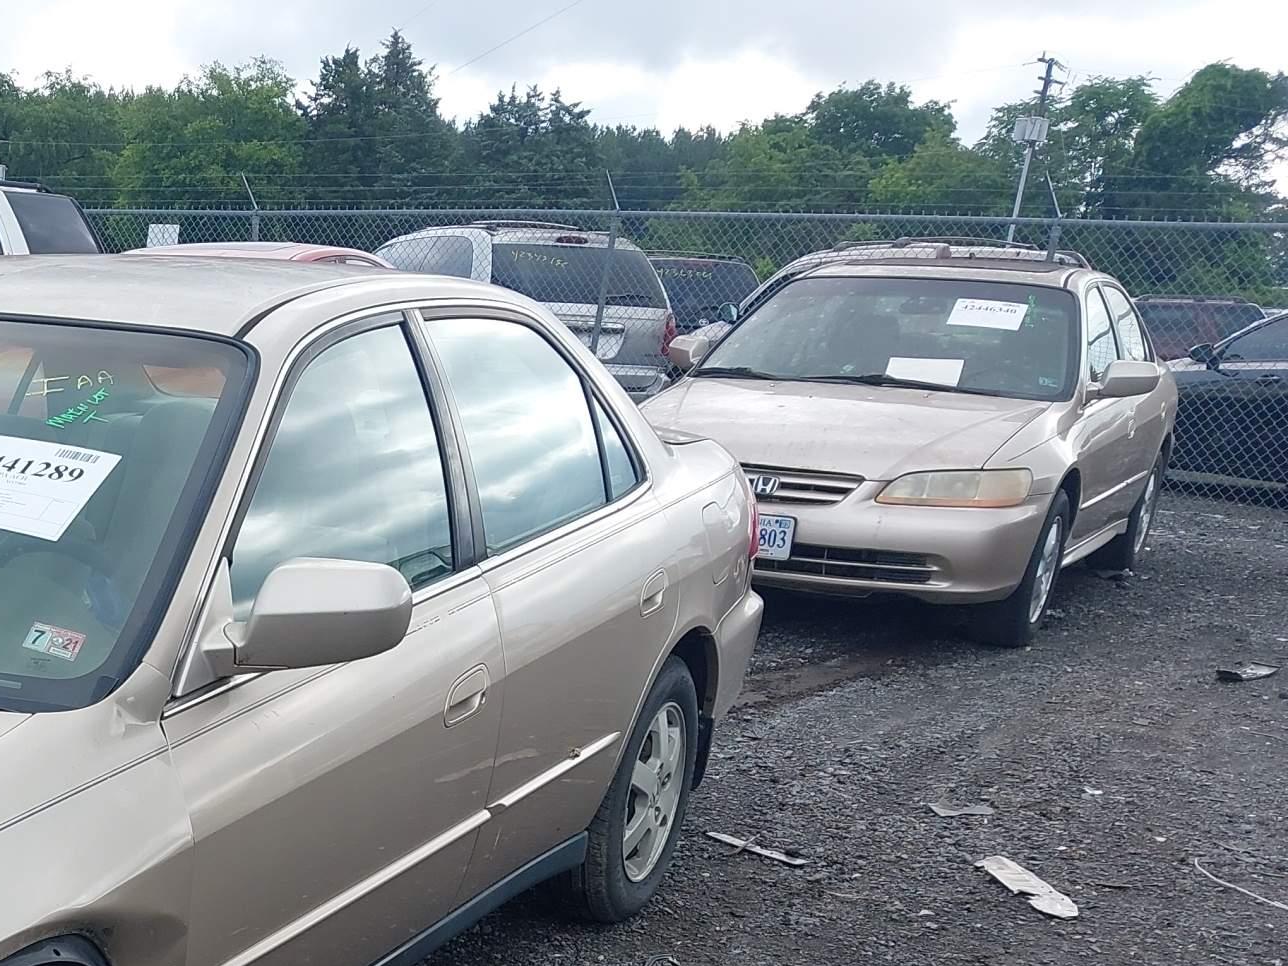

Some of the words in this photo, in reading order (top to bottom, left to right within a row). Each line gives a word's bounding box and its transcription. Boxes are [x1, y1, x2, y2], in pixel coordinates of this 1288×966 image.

[759, 528, 787, 549] 803
[31, 629, 46, 645] 7
[63, 638, 79, 651] 21
